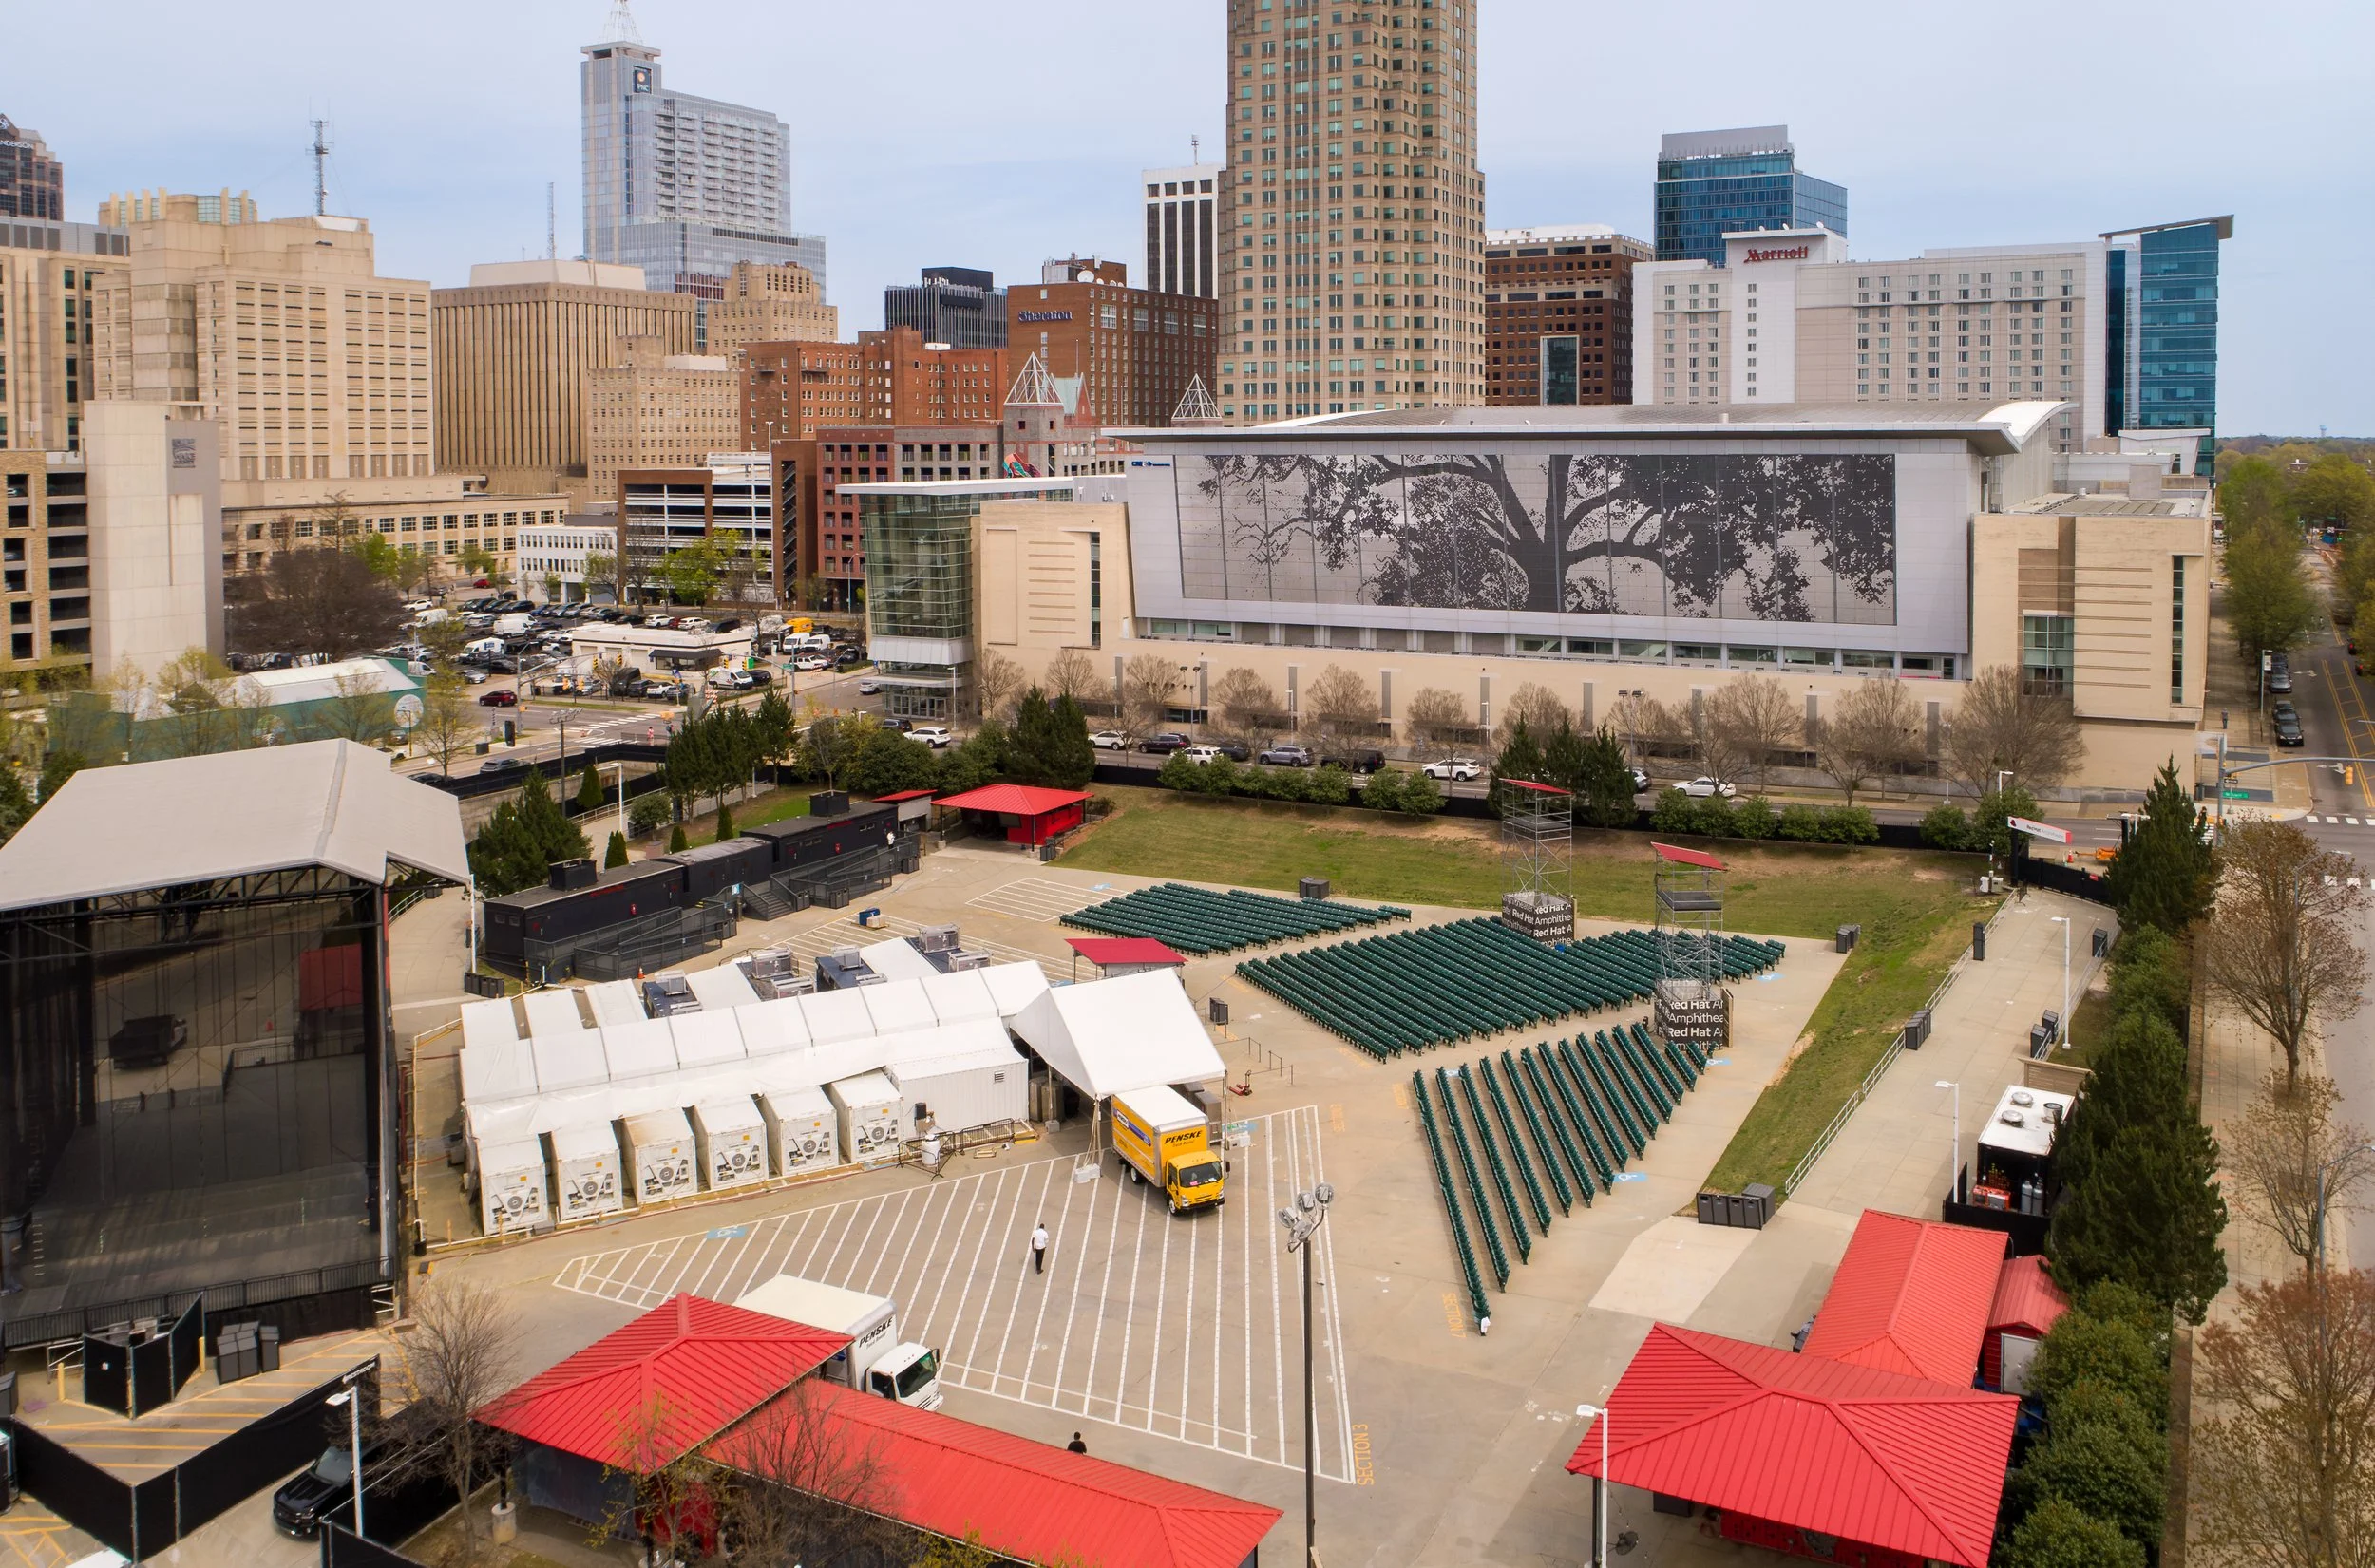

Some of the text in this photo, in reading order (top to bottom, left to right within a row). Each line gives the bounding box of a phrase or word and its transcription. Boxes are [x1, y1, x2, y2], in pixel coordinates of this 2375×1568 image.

[1743, 245, 1808, 263] Marriott
[1018, 310, 1073, 321] Sheraton
[1533, 927, 1549, 937] Red
[1550, 925, 1566, 935] Hat
[1691, 1000, 1711, 1010] Hat
[1691, 1027, 1712, 1037] Hat
[1165, 1130, 1202, 1144] PENSKE
[1442, 1293, 1464, 1332] SECTION
[859, 1317, 893, 1349] PENSKE
[1353, 1432, 1375, 1485] SECTION
